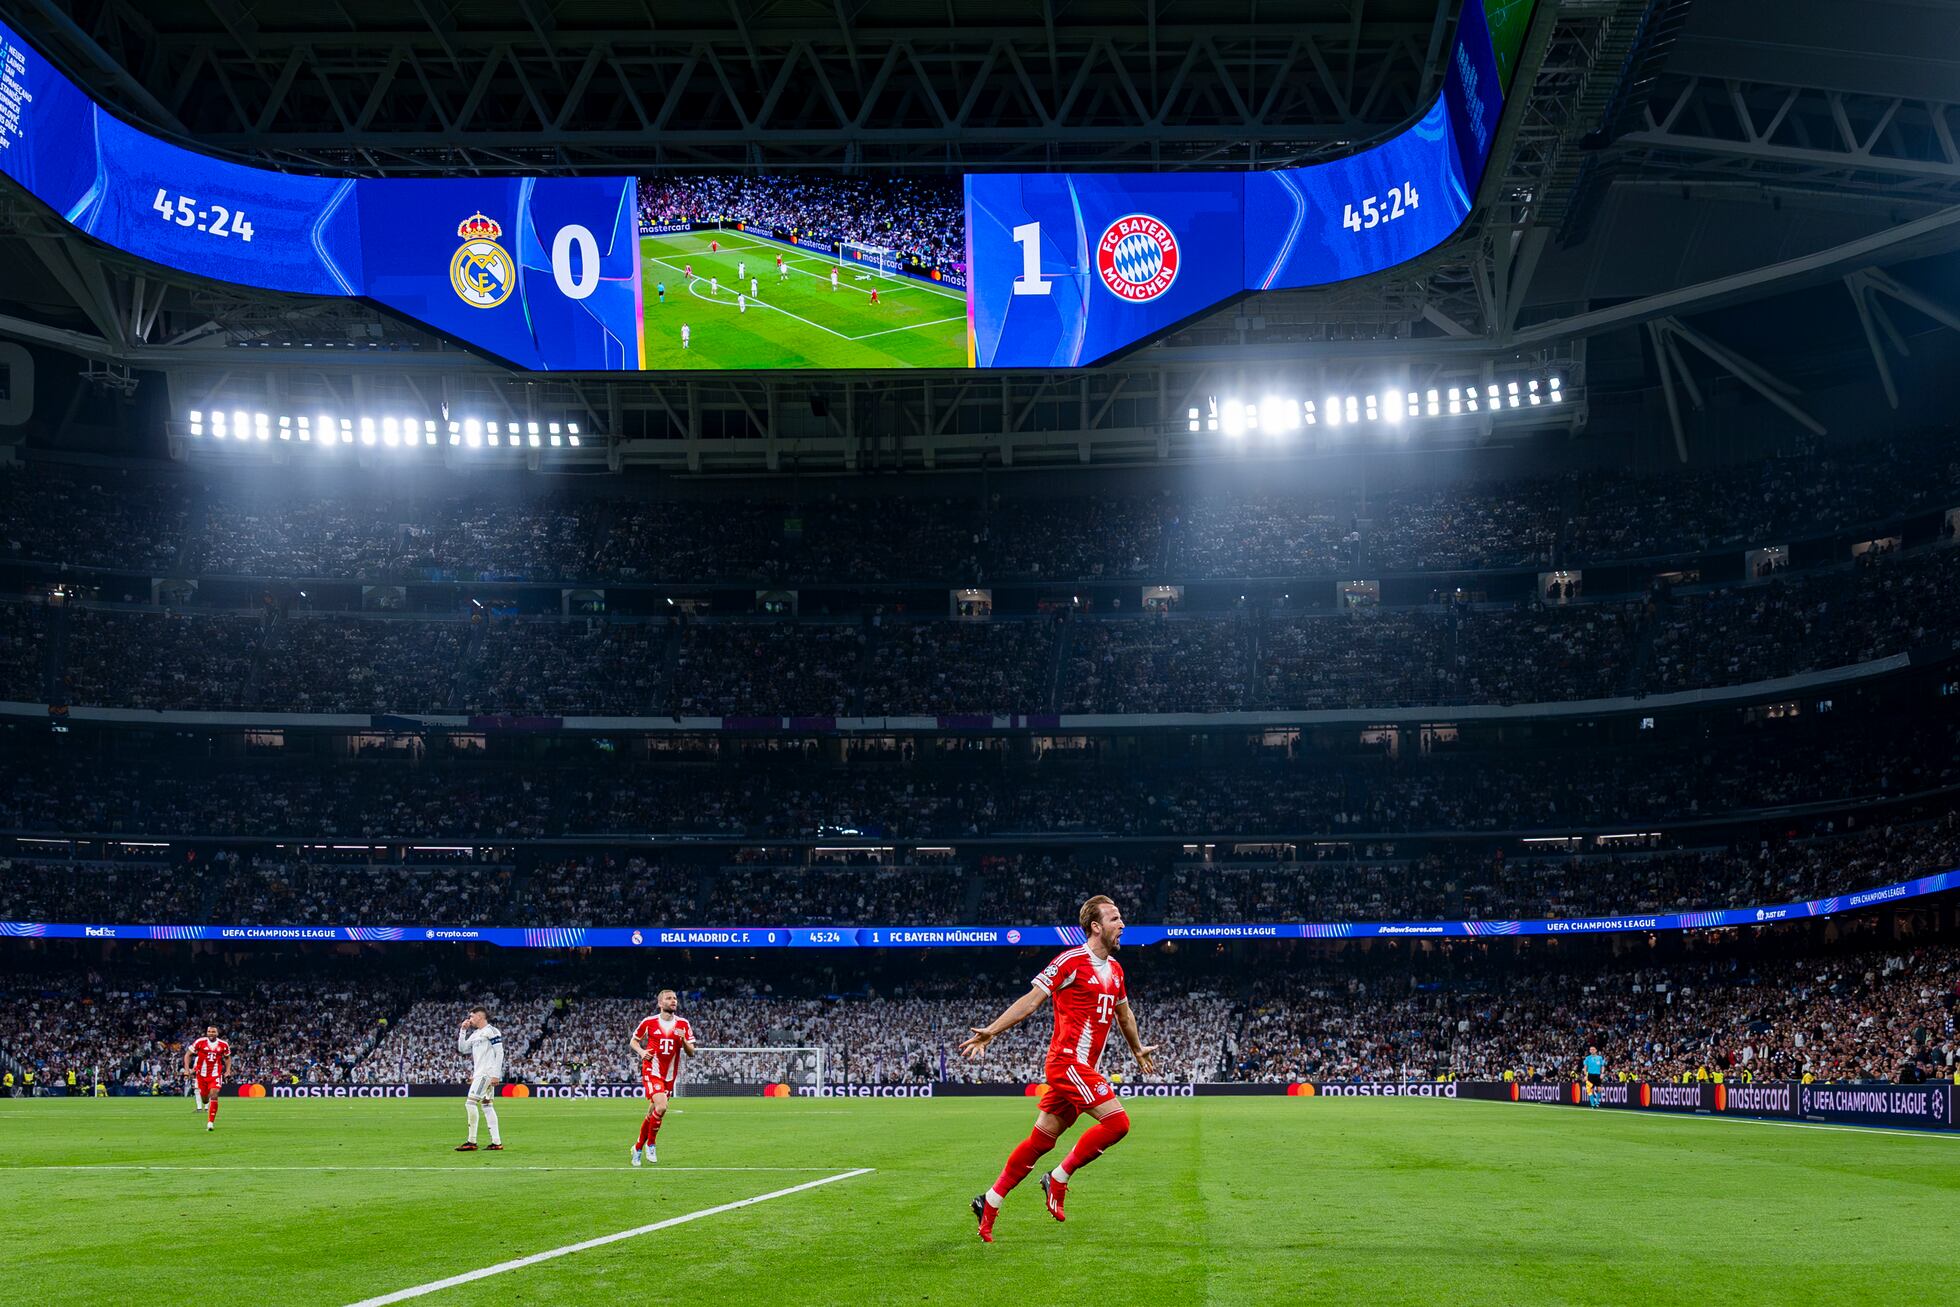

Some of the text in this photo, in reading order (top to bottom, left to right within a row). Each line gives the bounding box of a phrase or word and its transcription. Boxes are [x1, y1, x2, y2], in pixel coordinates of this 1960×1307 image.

[1343, 180, 1420, 232] 45:24
[152, 187, 255, 242] 45:24
[640, 223, 690, 233] mastercard
[744, 225, 773, 238] mastercard
[1102, 219, 1174, 253] FC BAYERN
[797, 238, 832, 252] mastercard
[551, 224, 600, 300] 0
[1013, 221, 1052, 295] 1
[1103, 266, 1174, 298] MÜNCHEN
[1861, 890, 1888, 903] CHAMPIONS
[1888, 886, 1906, 898] LEAGUE
[85, 926, 116, 937] FedEx
[1167, 927, 1277, 936] UEFA CHAMPIONS LEAGUE
[1547, 919, 1656, 931] UEFA CHAMPIONS LEAGUE
[222, 929, 336, 938] UEFA CHAMPIONS LEAGUE
[436, 929, 479, 939] crypto.com
[660, 932, 687, 943] REAL
[688, 932, 729, 943] MADRID
[767, 932, 776, 943] 0
[809, 932, 840, 943] 45:24
[872, 932, 880, 943] 1
[890, 930, 998, 942] FC BAYERN MÜNCHEN
[1096, 993, 1115, 1024] T
[659, 1038, 674, 1055] T
[272, 1083, 409, 1098] mastercard
[536, 1083, 647, 1098] masterca
[798, 1082, 933, 1097] mastercard
[1112, 1082, 1194, 1097] tercard
[1321, 1081, 1457, 1098] mastercard
[1519, 1082, 1560, 1102] mastercard
[1651, 1083, 1701, 1107] mastercard
[1728, 1084, 1790, 1111] mastercard
[1813, 1090, 1927, 1115] UEFA CHAMPIONS LEAGUE
